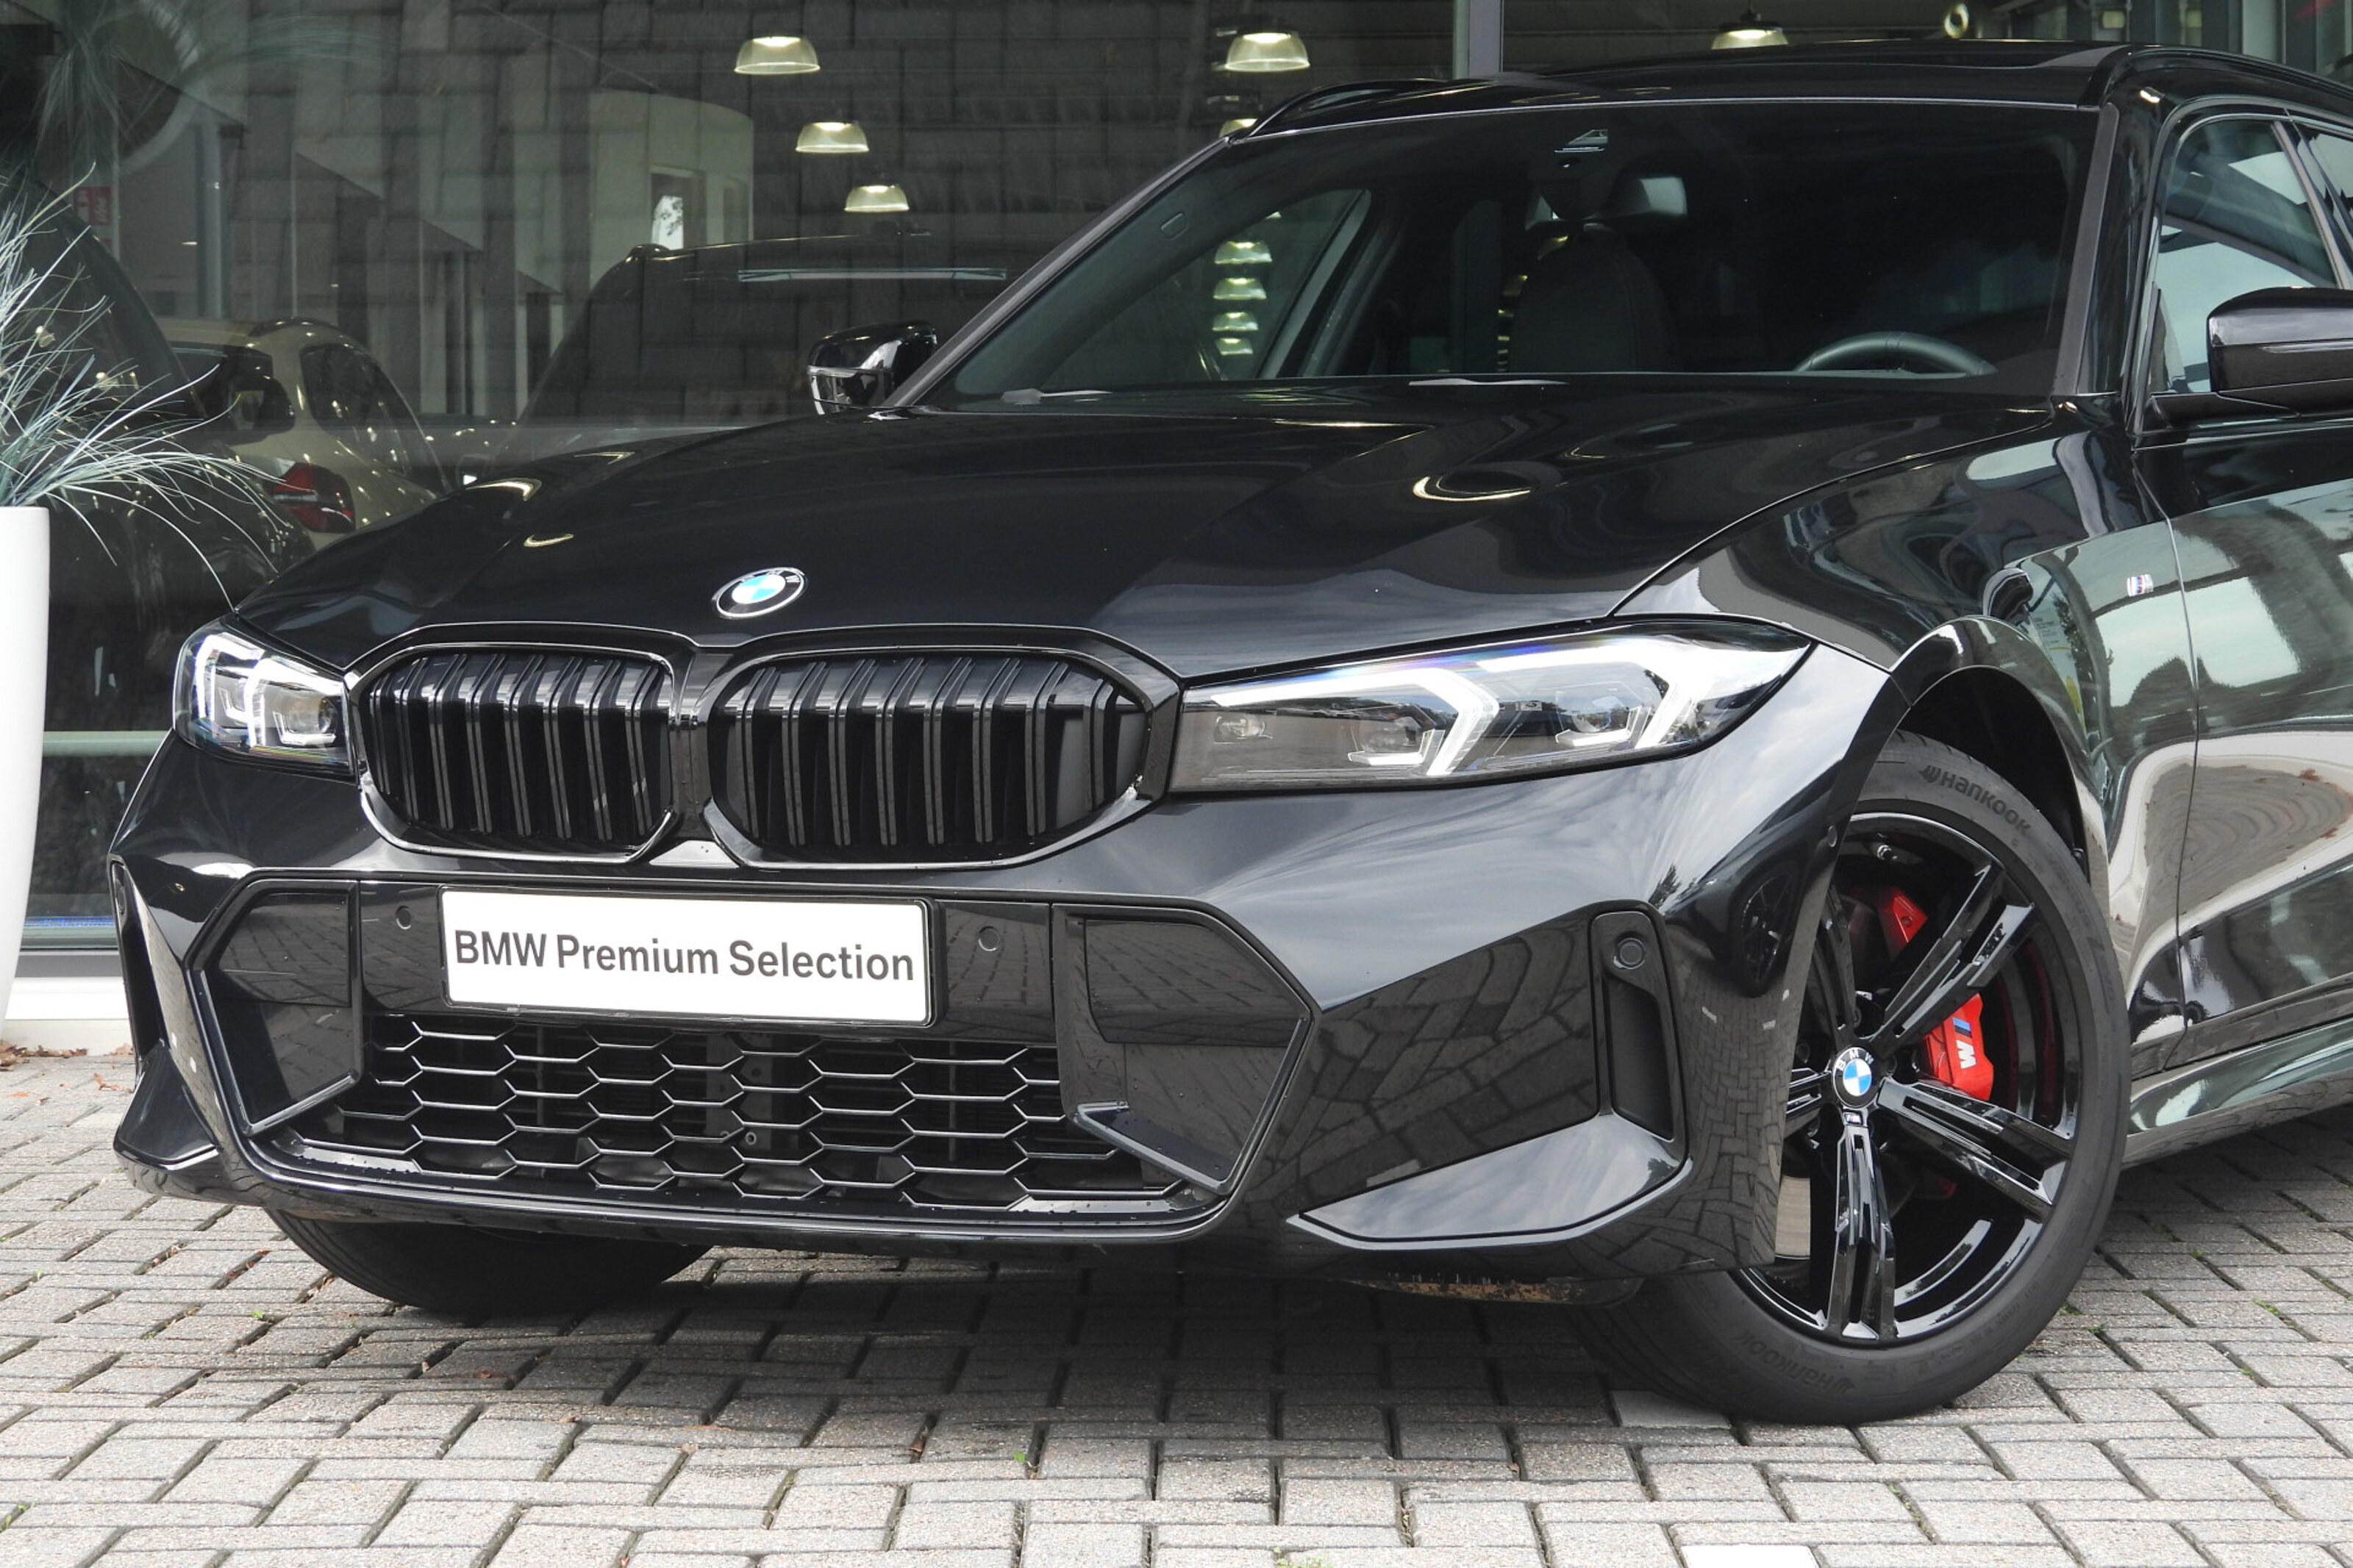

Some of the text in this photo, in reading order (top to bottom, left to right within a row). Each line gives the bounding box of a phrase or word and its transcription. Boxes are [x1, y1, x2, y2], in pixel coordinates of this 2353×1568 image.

[454, 929, 914, 981] BMW Premium Selection
[1835, 1048, 1874, 1072] BMW
[1955, 1039, 1977, 1070] M
